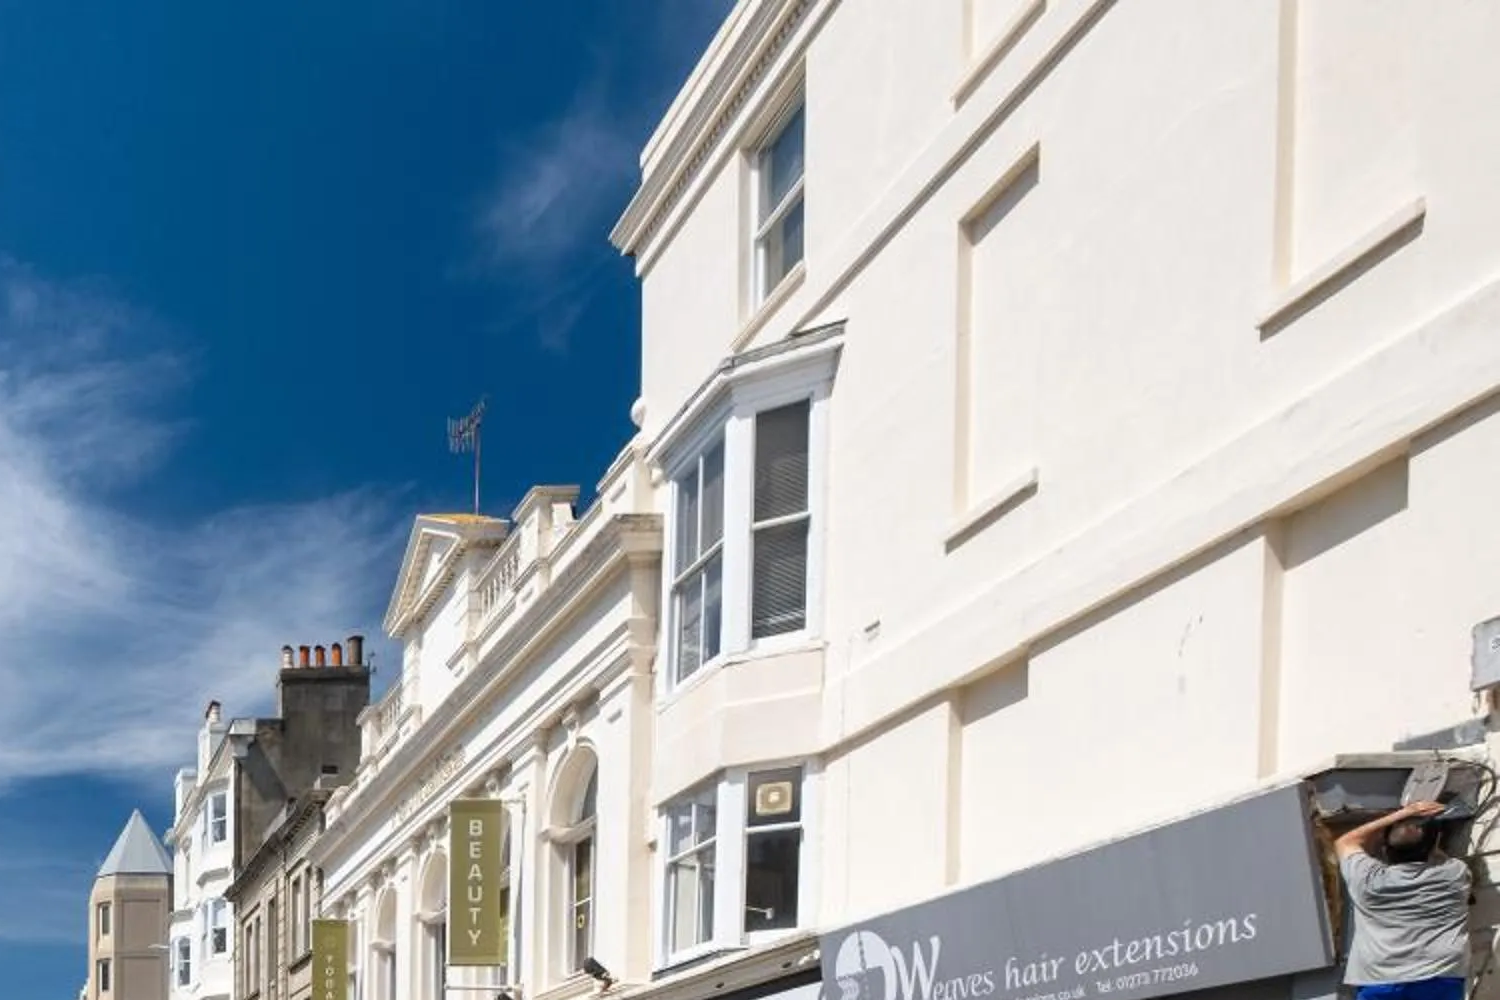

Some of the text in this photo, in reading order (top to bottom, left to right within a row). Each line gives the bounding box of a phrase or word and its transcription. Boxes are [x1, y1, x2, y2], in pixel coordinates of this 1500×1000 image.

[467, 818, 484, 946] BEAUTY
[1005, 953, 1066, 990] hair
[1074, 913, 1257, 975] extensions
